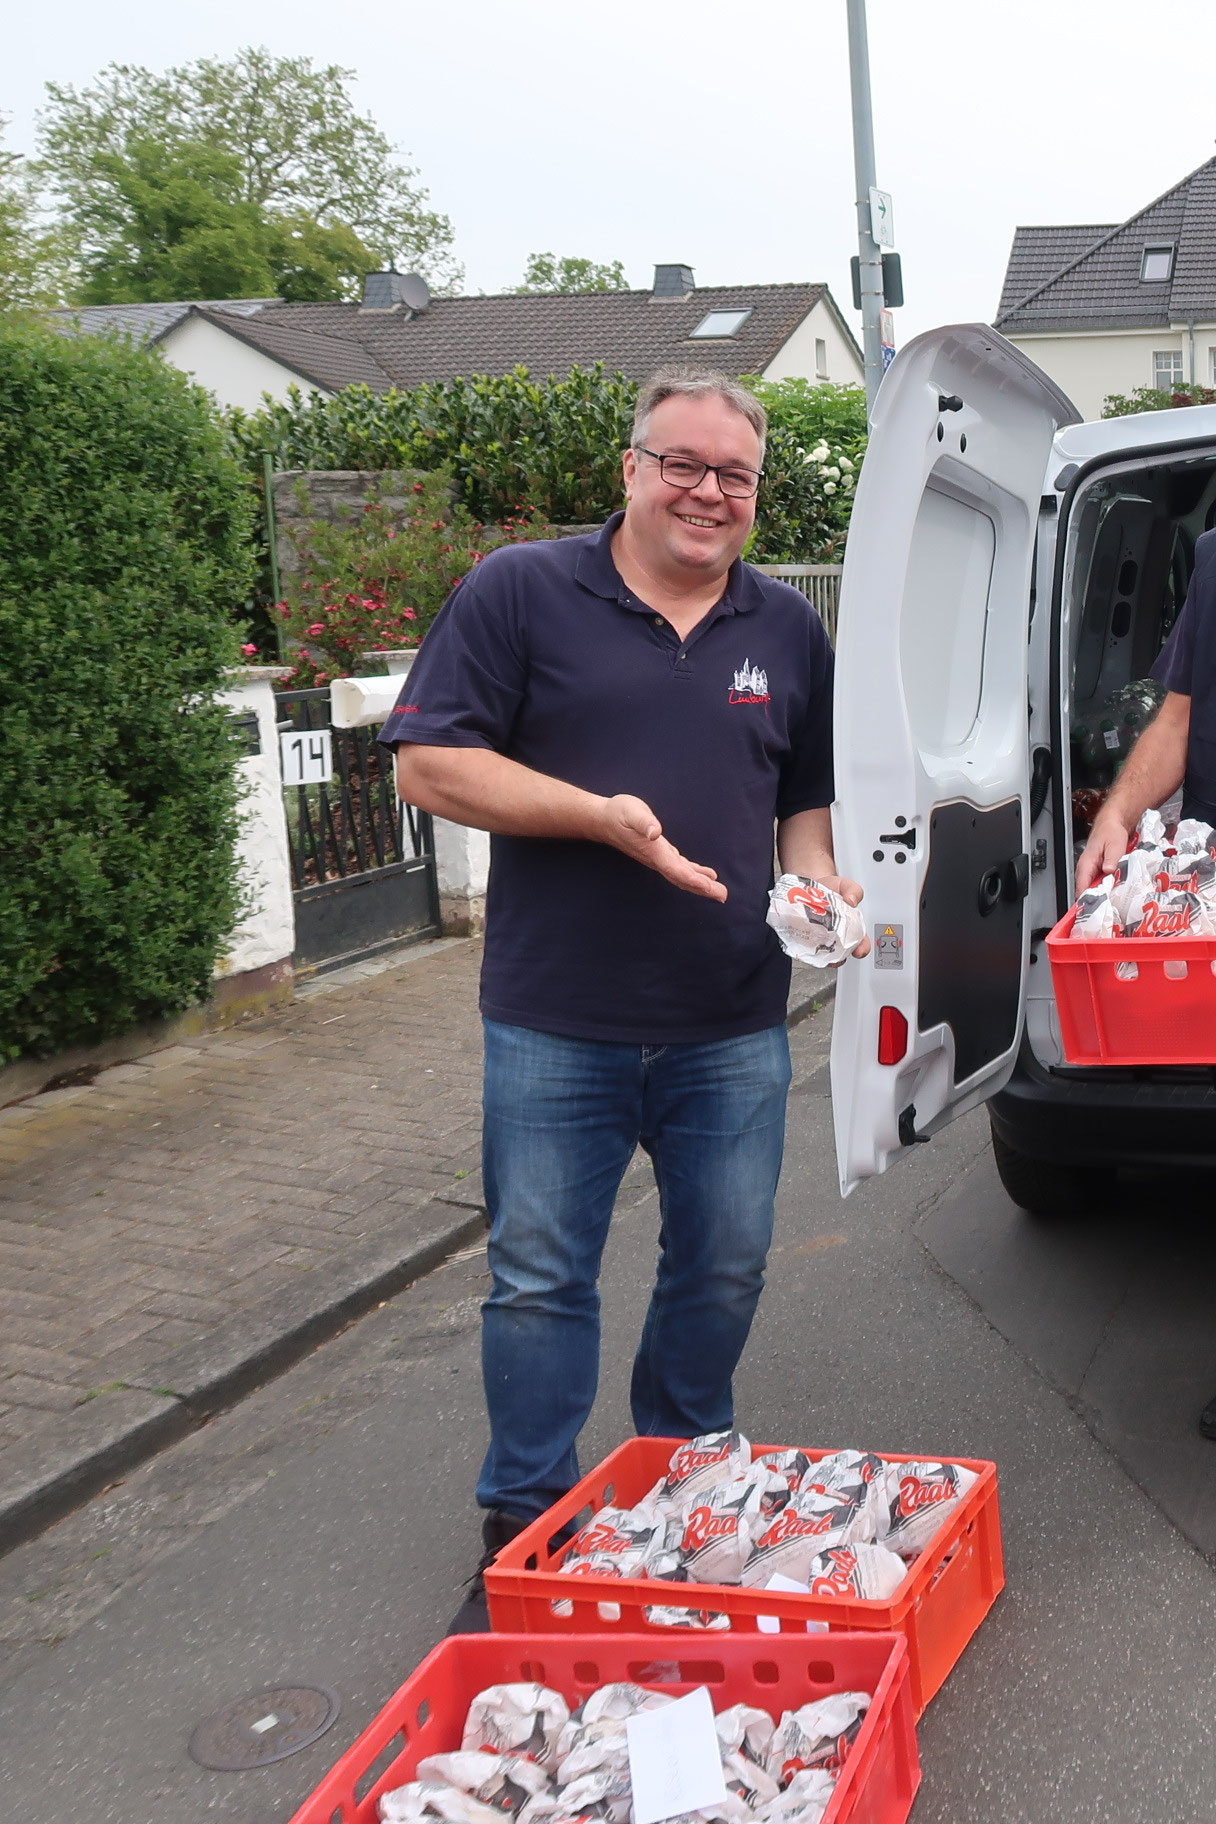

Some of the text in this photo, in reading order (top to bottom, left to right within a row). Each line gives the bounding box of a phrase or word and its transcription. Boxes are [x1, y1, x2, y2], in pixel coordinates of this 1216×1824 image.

[291, 736, 325, 780] 14
[896, 1475, 957, 1518] Raab
[756, 1508, 834, 1549] Raab
